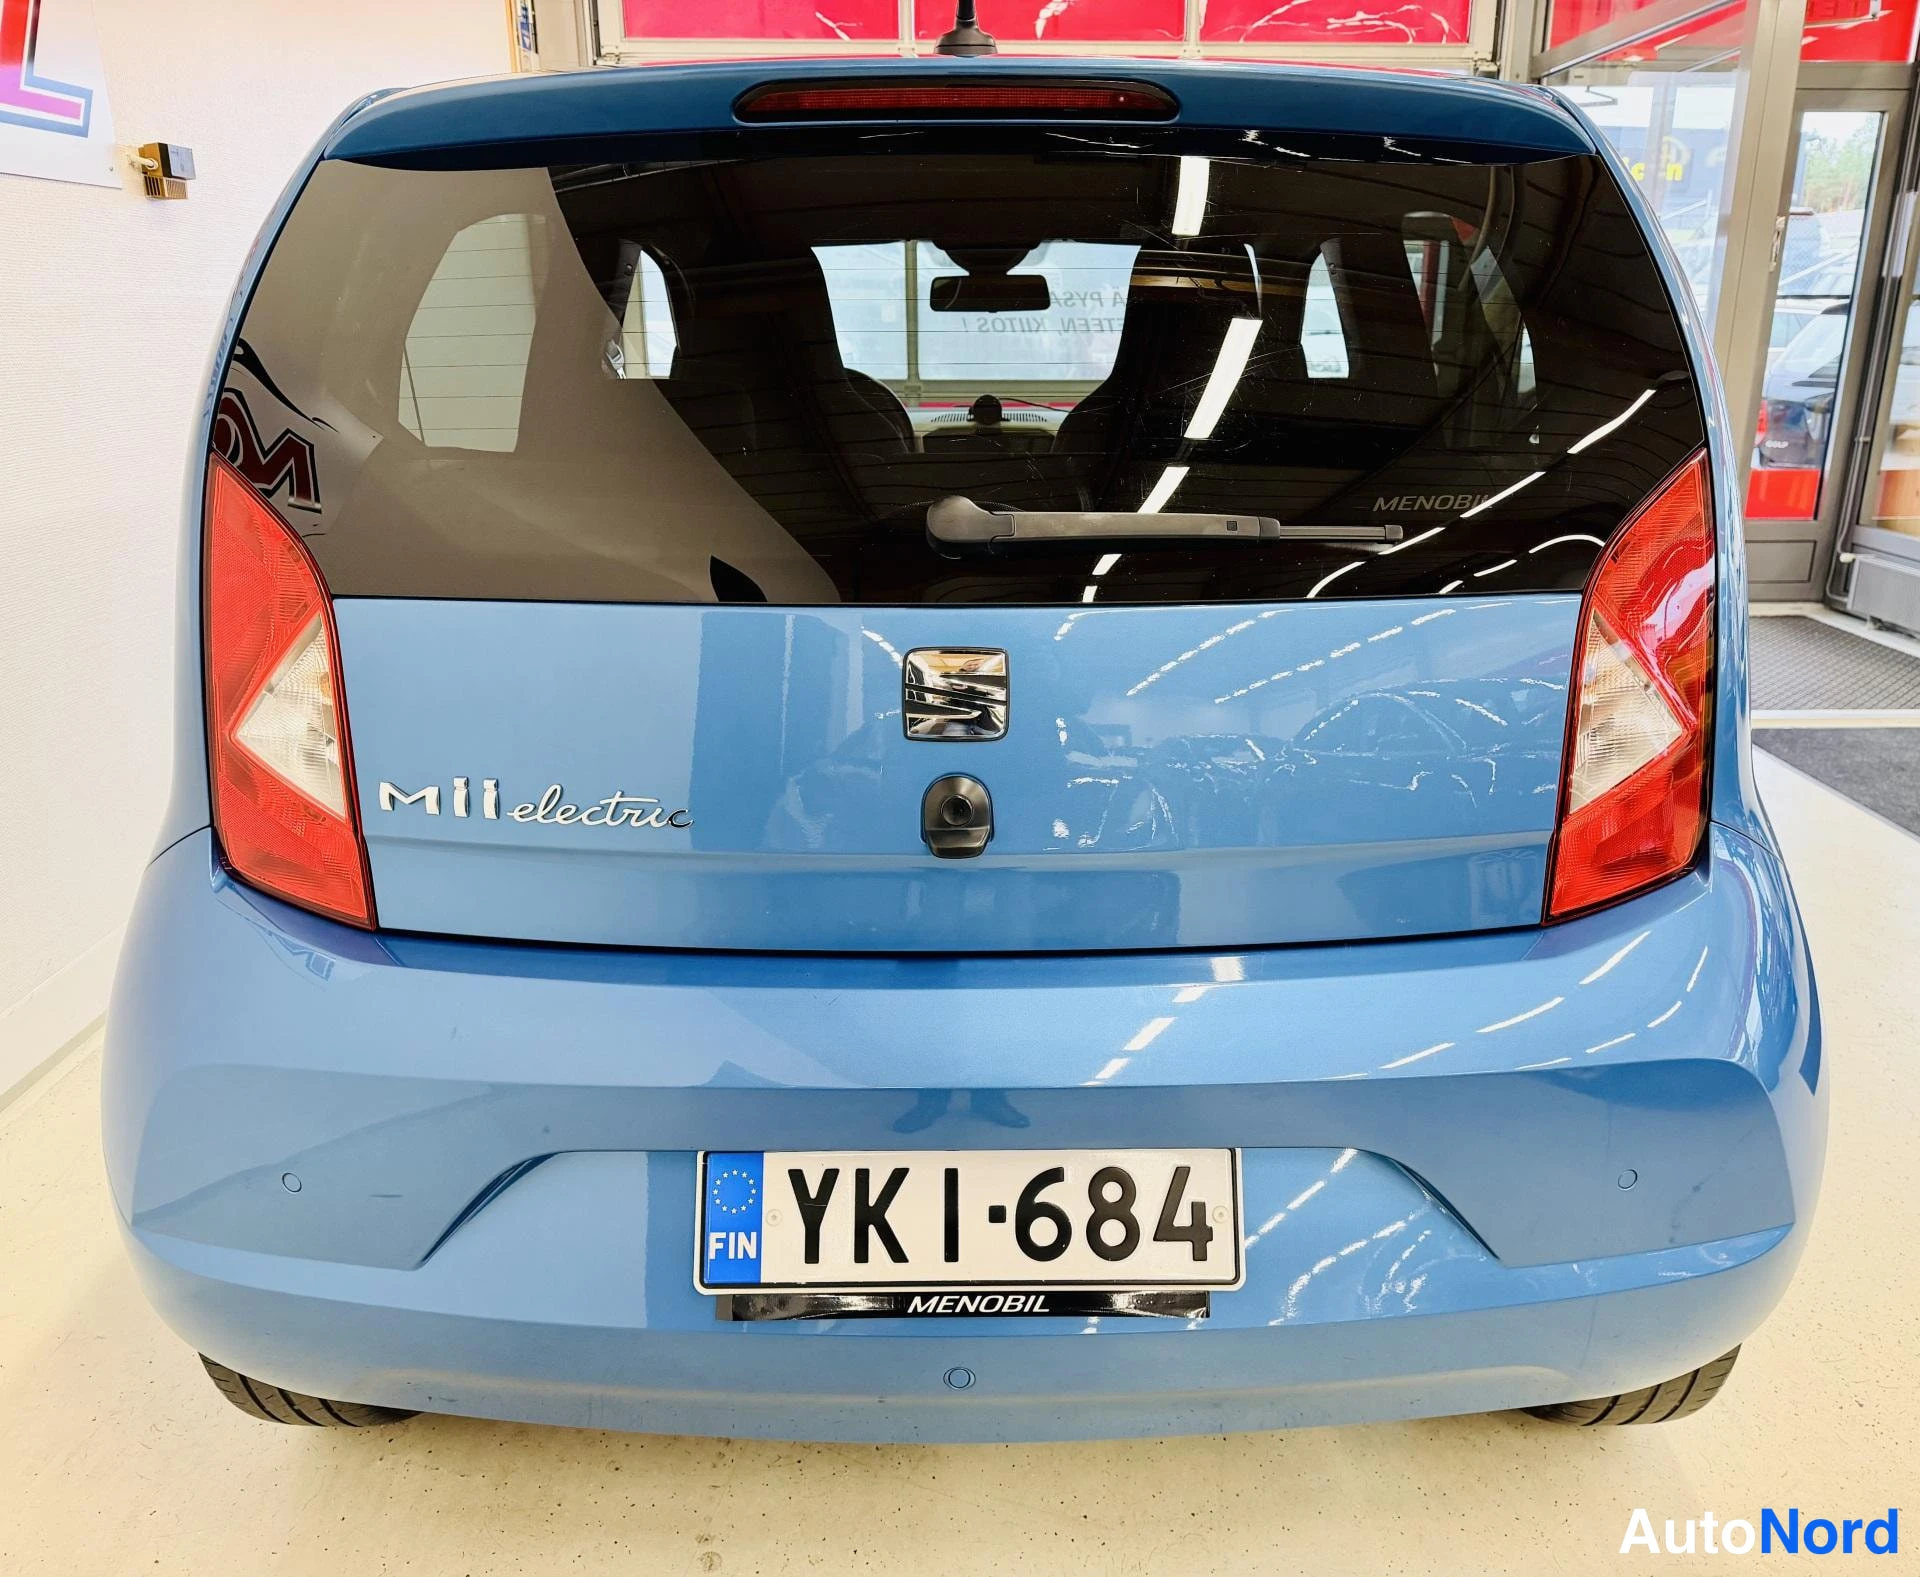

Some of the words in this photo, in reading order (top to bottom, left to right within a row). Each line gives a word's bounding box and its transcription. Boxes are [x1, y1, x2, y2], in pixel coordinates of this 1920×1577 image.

[507, 784, 693, 828] electric
[708, 1231, 757, 1260] FIN
[788, 1166, 1214, 1264] YKI-684
[907, 1295, 1050, 1313] MENOBIL
